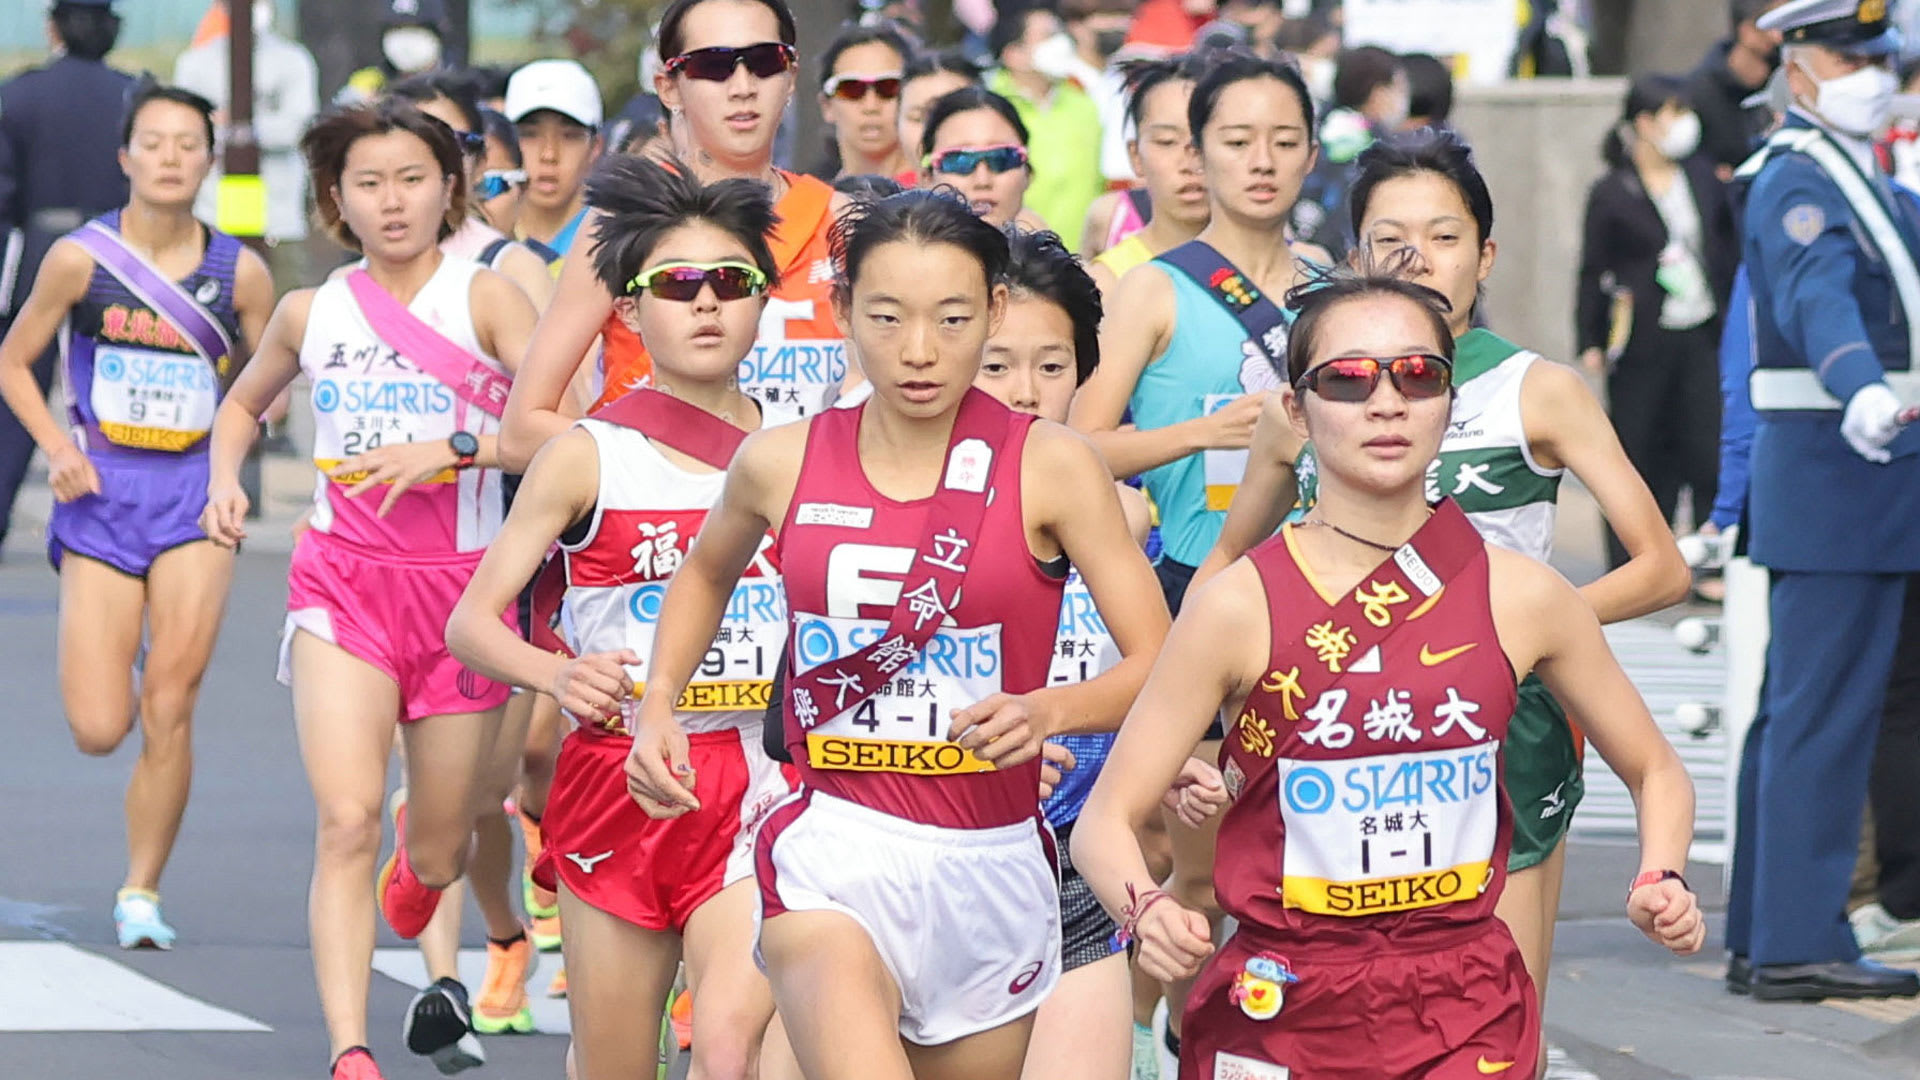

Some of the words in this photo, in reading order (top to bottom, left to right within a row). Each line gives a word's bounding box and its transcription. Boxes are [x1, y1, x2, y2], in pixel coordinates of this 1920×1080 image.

[325, 343, 424, 374] 玉川大
[345, 380, 453, 415] STARTS
[353, 416, 401, 431] 玉川大
[848, 627, 997, 680] SRTS
[1052, 639, 1096, 659] 育大
[852, 699, 938, 738] 4-1
[1298, 688, 1487, 749] 名城大
[822, 739, 964, 770] SEIKO
[1343, 751, 1492, 814] STARTS
[1360, 810, 1429, 836] 名城大
[1361, 832, 1432, 875] 1-1
[1326, 870, 1462, 912] SEIKO
